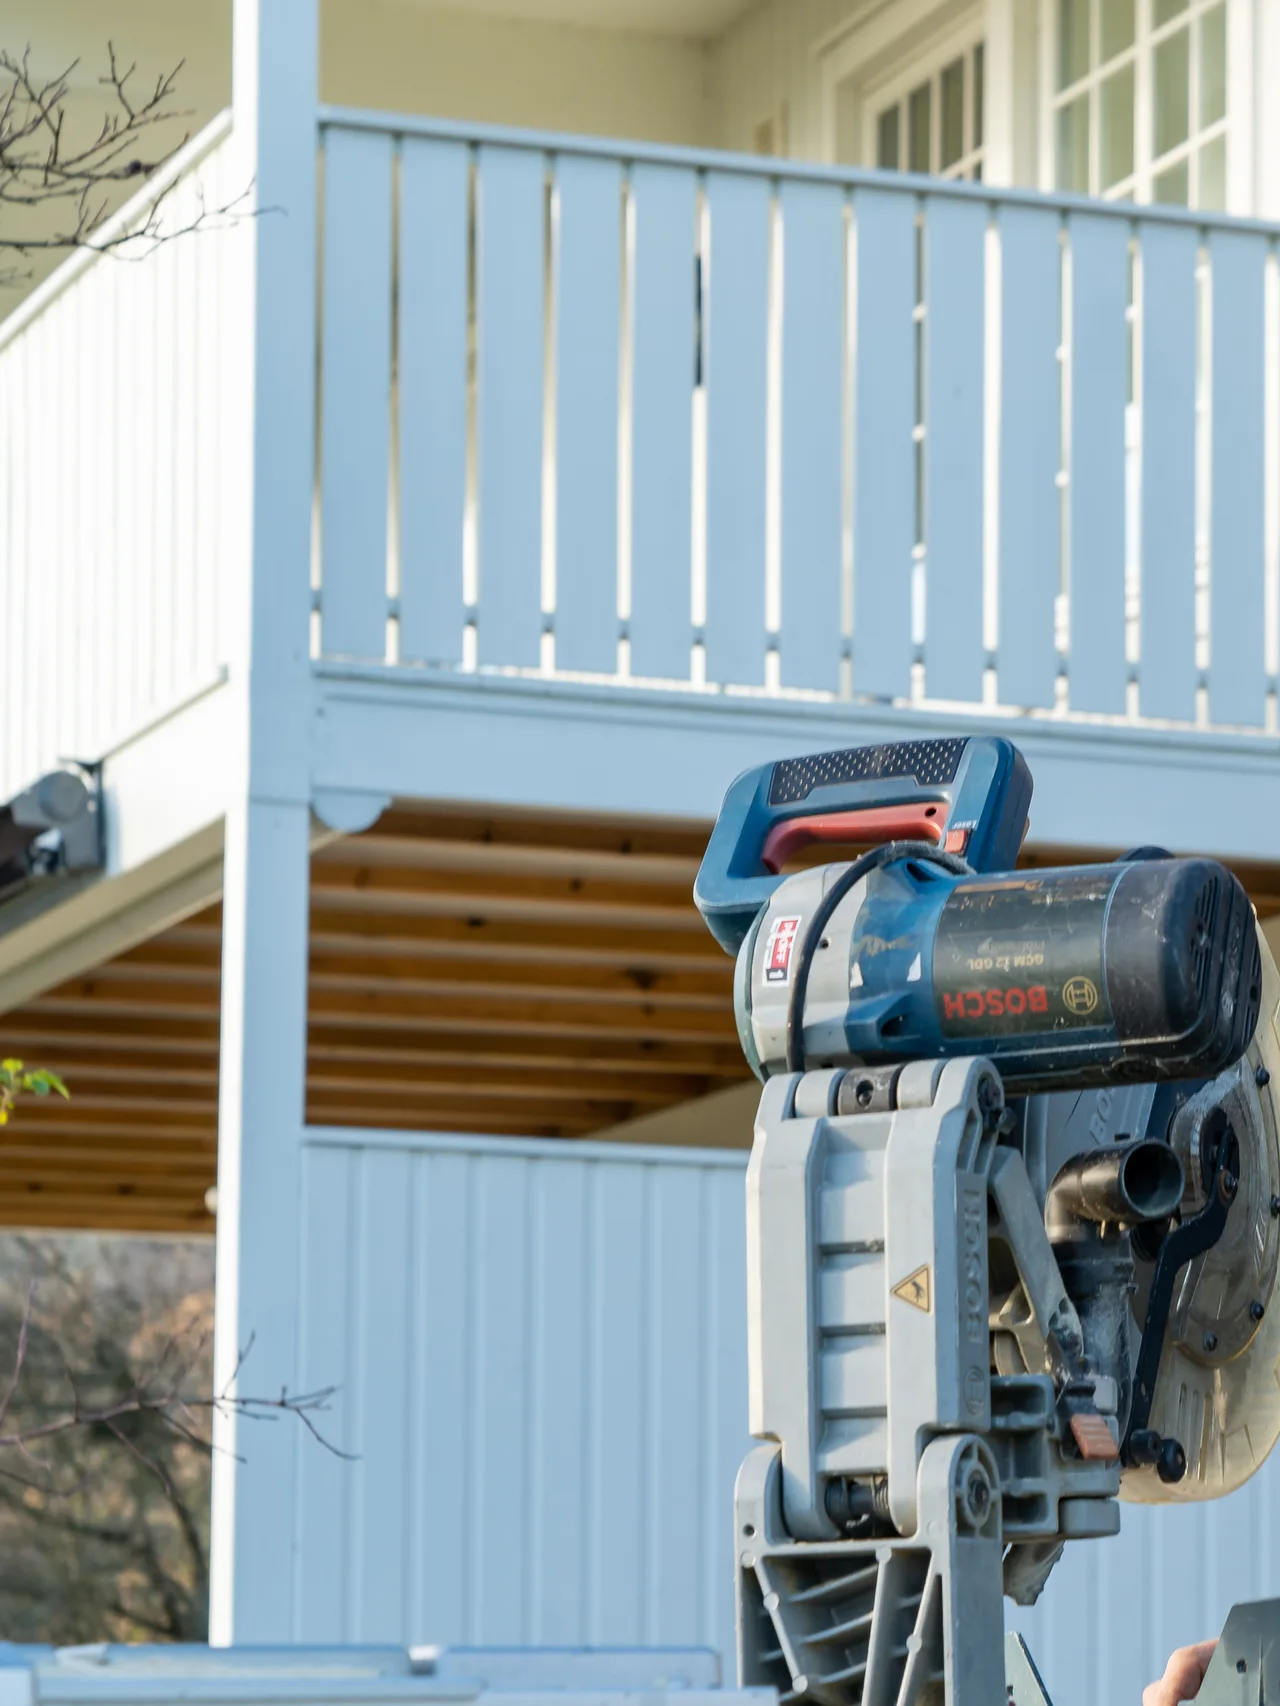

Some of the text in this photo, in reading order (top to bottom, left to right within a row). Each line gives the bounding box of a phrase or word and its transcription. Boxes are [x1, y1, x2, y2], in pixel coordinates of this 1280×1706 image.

[996, 956, 1011, 970] 12
[1013, 953, 1044, 967] GCM
[943, 985, 1048, 1020] BOSCH
[963, 1188, 983, 1345] BOSCH
